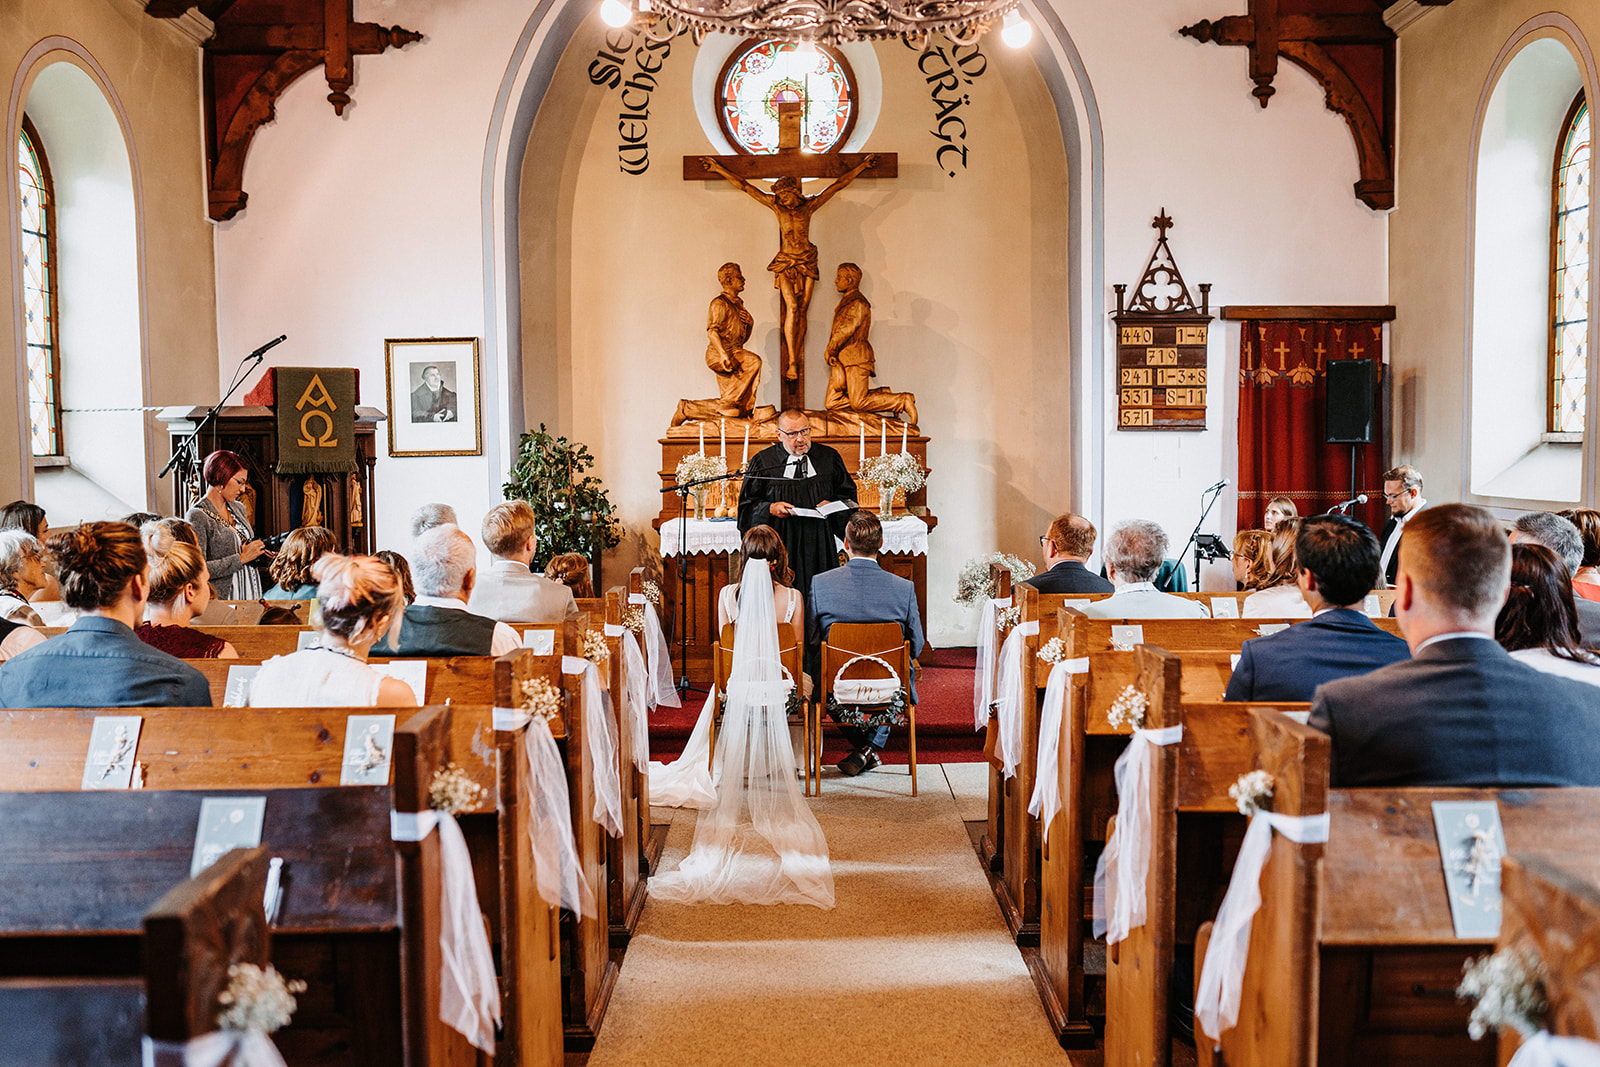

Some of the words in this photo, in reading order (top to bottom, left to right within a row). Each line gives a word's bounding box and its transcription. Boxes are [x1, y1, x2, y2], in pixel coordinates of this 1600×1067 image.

[1123, 329, 1152, 343] 440
[1177, 328, 1206, 343] 1-4
[1148, 349, 1176, 363] 719
[1122, 370, 1149, 384] 241
[1122, 390, 1149, 404] 331
[1167, 390, 1203, 404] 8-11
[1122, 410, 1150, 425] 571
